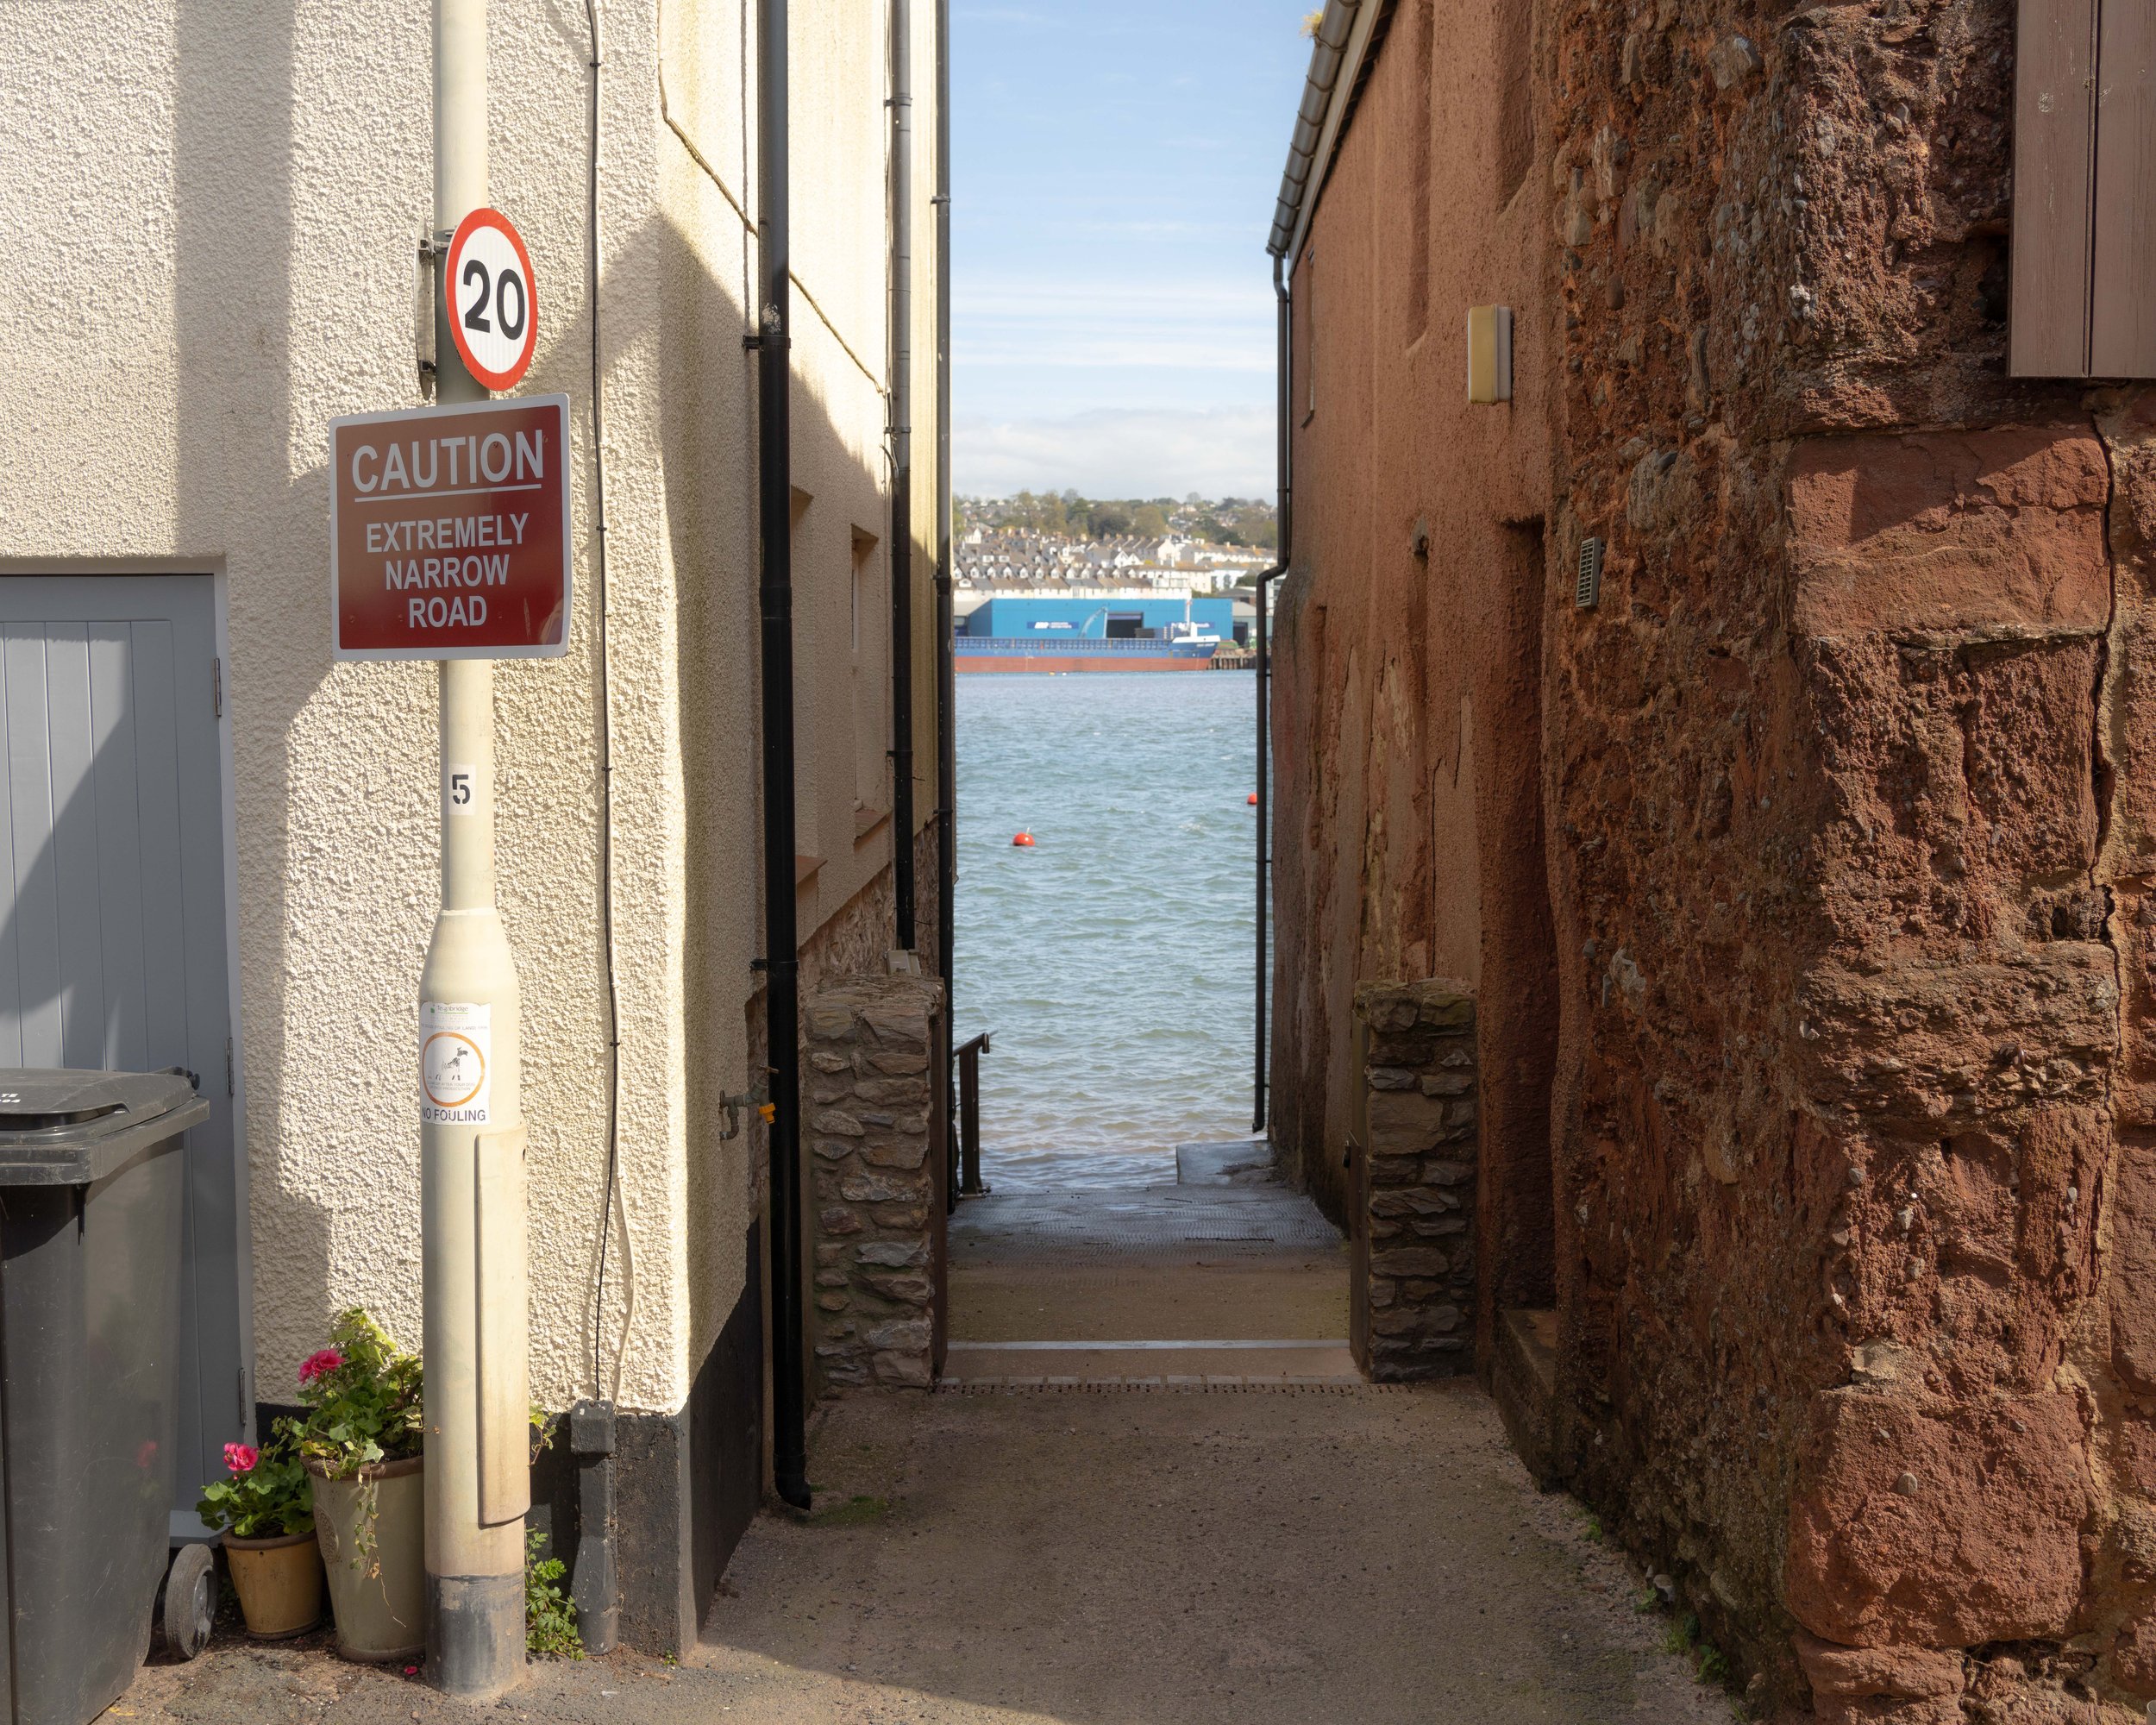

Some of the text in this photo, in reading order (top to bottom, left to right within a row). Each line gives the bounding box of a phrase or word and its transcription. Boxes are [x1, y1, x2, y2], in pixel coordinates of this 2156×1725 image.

[463, 259, 525, 341] 20
[352, 429, 544, 493] CAUTION
[367, 512, 529, 554] EXTREMELY
[385, 554, 510, 591] NARROW
[409, 595, 487, 629] ROAD
[452, 774, 471, 805] 5
[423, 1107, 486, 1121] NO FOULING
